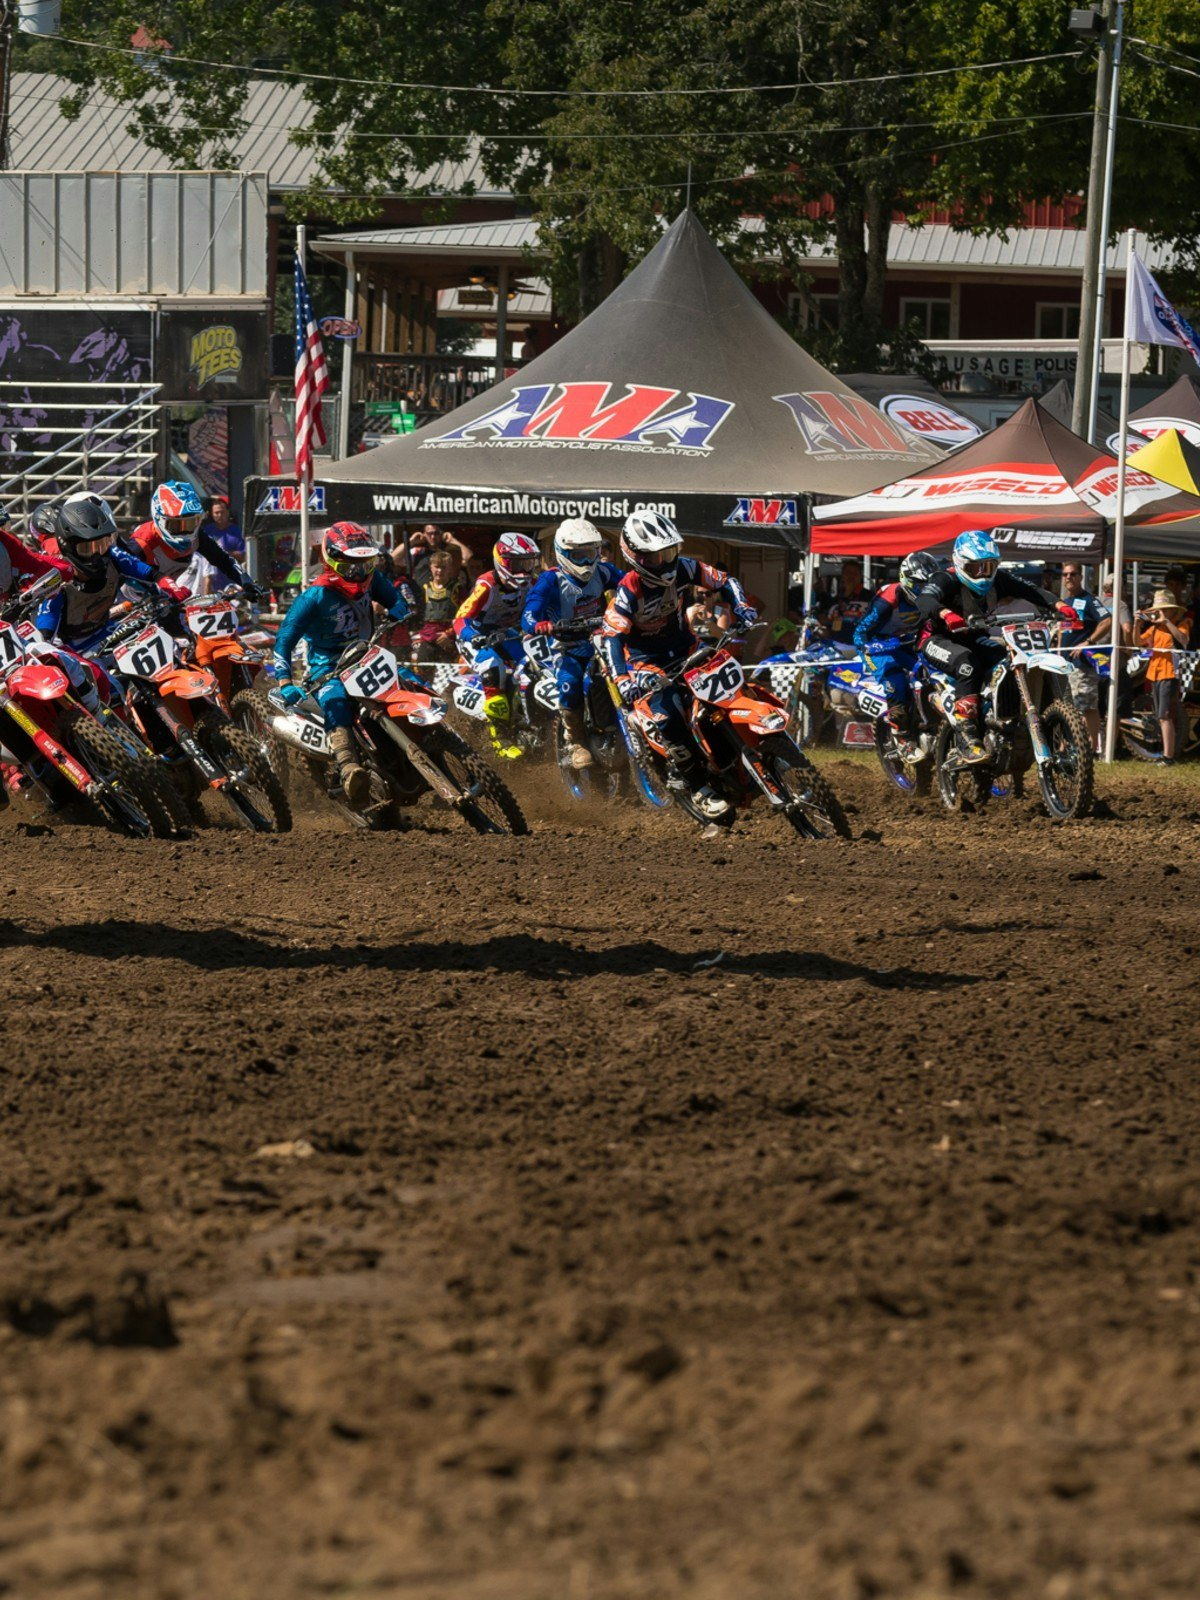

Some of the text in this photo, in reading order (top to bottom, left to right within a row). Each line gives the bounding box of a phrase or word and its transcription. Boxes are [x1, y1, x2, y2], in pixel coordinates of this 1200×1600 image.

[323, 320, 358, 336] OPEN
[190, 327, 236, 367] MOTO
[198, 348, 242, 386] TEES
[939, 357, 1077, 376] AUSAGE POLIS
[422, 382, 736, 451] AMA
[897, 410, 970, 432] BELL
[417, 439, 711, 458] AMERICAN MOTORCYCLIST ASSOCIATION
[255, 486, 328, 514] AMA
[373, 493, 676, 520] www.AmericanMotorcyclist.com
[722, 498, 800, 526] AMA
[198, 611, 236, 637] 24
[1013, 630, 1047, 651] 69
[131, 636, 167, 680] 67
[356, 655, 394, 696] 85
[707, 661, 741, 700] 26
[457, 689, 482, 710] 38
[860, 696, 882, 715] 95
[300, 724, 323, 748] 85
[186, 739, 215, 773] DULOP
